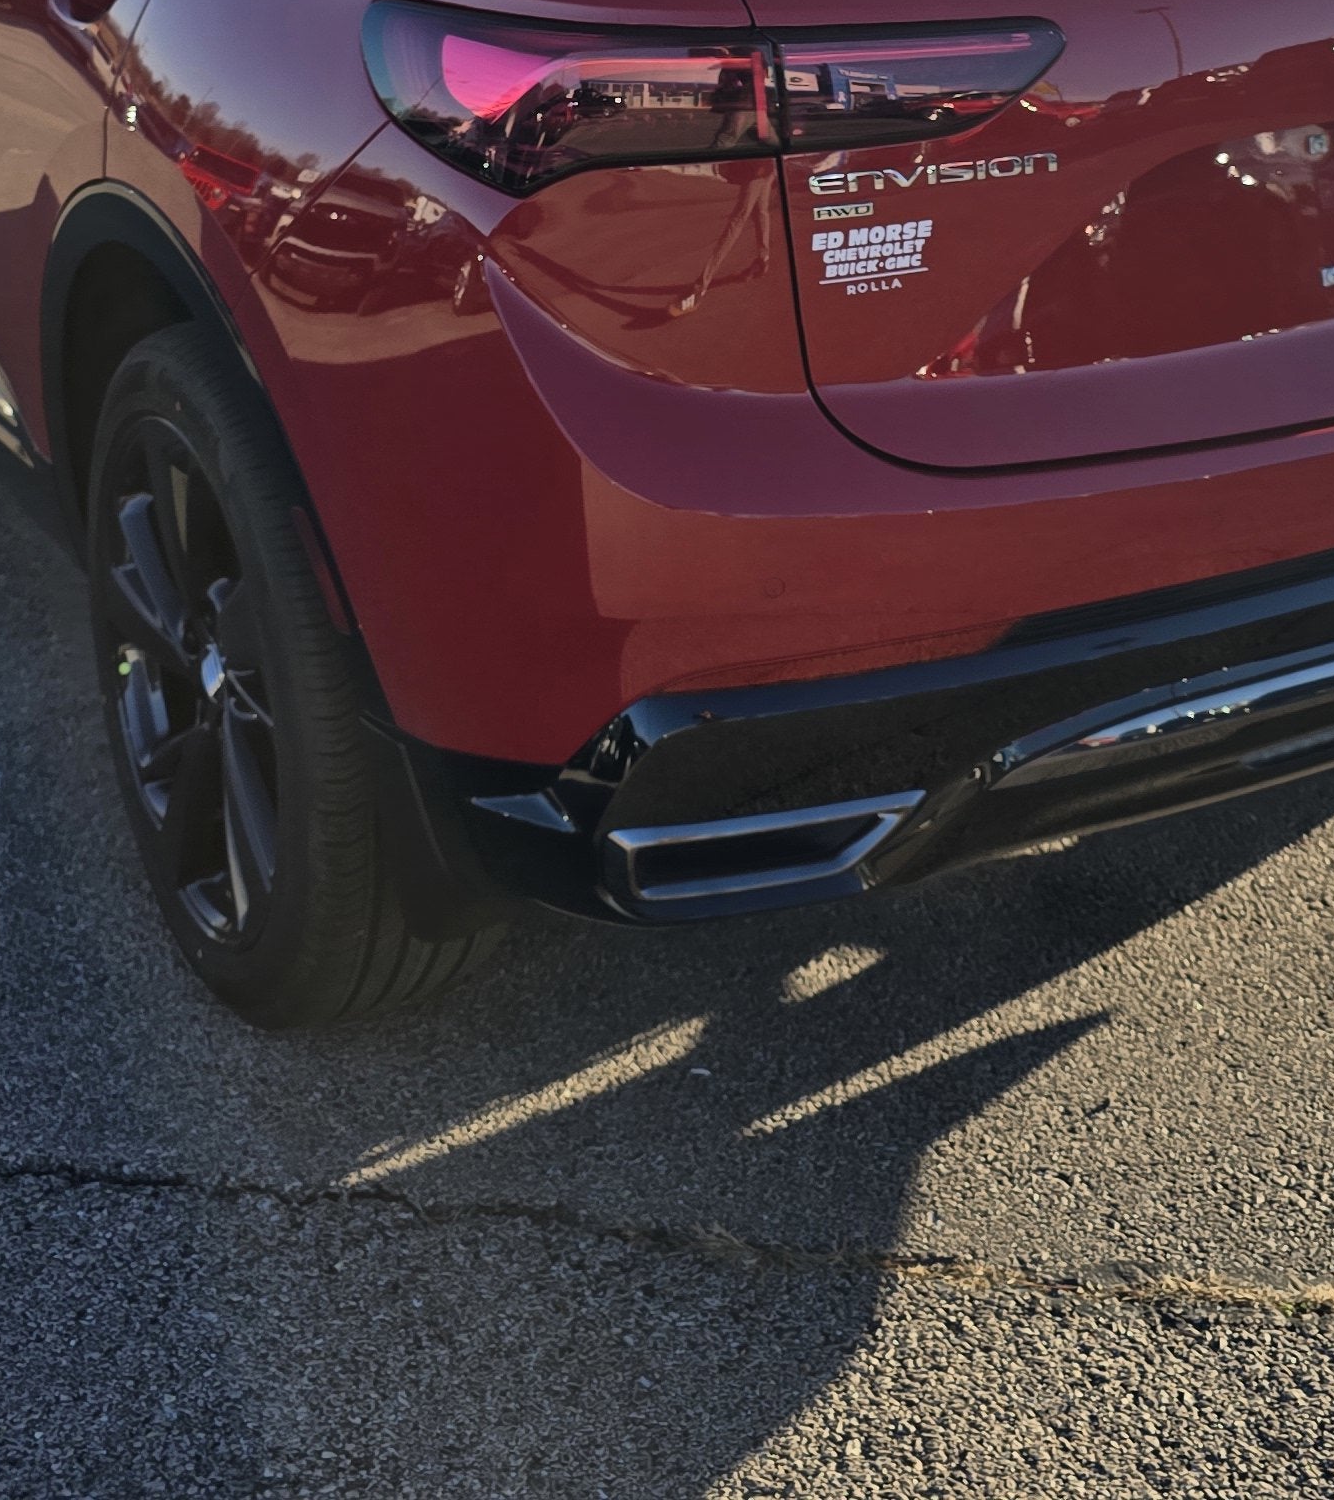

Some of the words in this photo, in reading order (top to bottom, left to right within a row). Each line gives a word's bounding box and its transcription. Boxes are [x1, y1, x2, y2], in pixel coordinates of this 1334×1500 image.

[808, 152, 1059, 195] ENVISION
[816, 203, 873, 220] AWD
[811, 230, 845, 251] ED
[847, 219, 934, 248] MORSE
[822, 238, 926, 265] CHEVROLET
[846, 277, 903, 296] ROLLA
